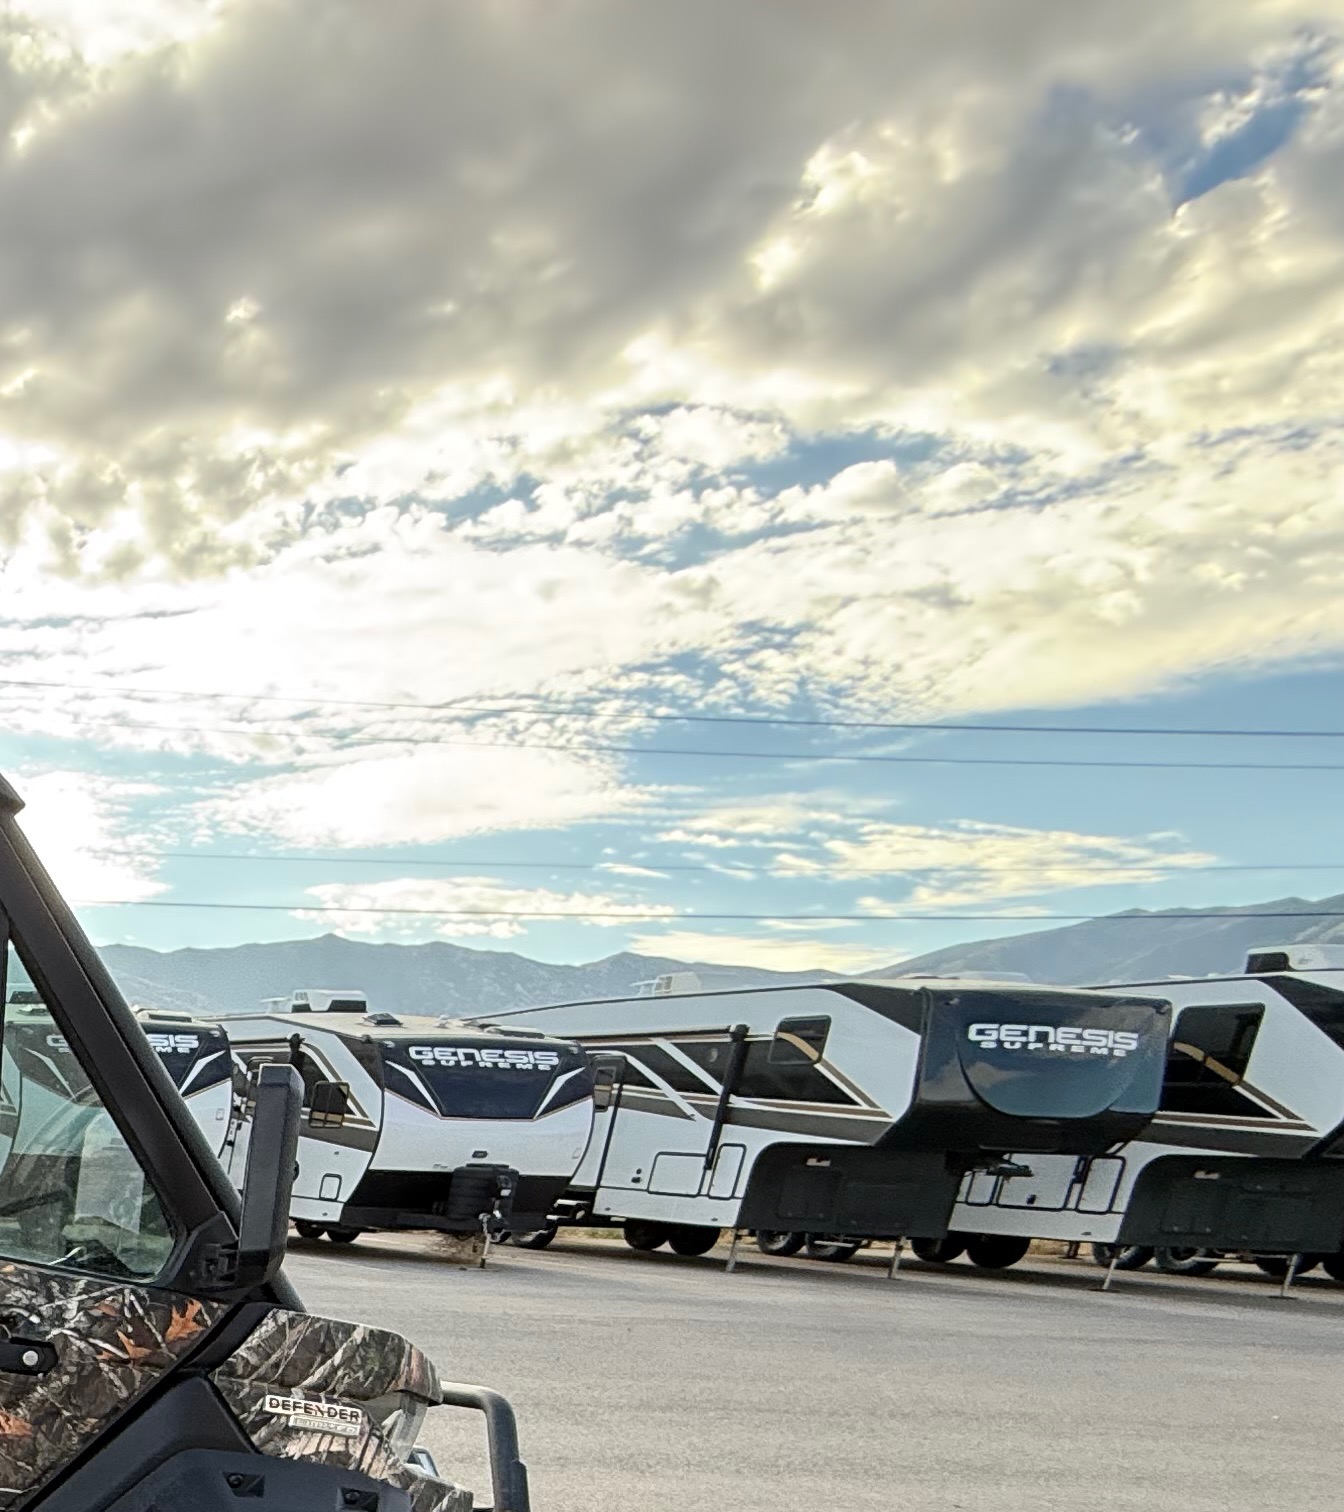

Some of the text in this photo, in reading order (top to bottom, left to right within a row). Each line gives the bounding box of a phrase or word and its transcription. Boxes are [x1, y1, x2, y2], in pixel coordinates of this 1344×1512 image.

[967, 1023, 1139, 1050] GENESIS
[409, 1046, 560, 1066] GENESIS
[268, 1397, 361, 1422] DEFENDER
